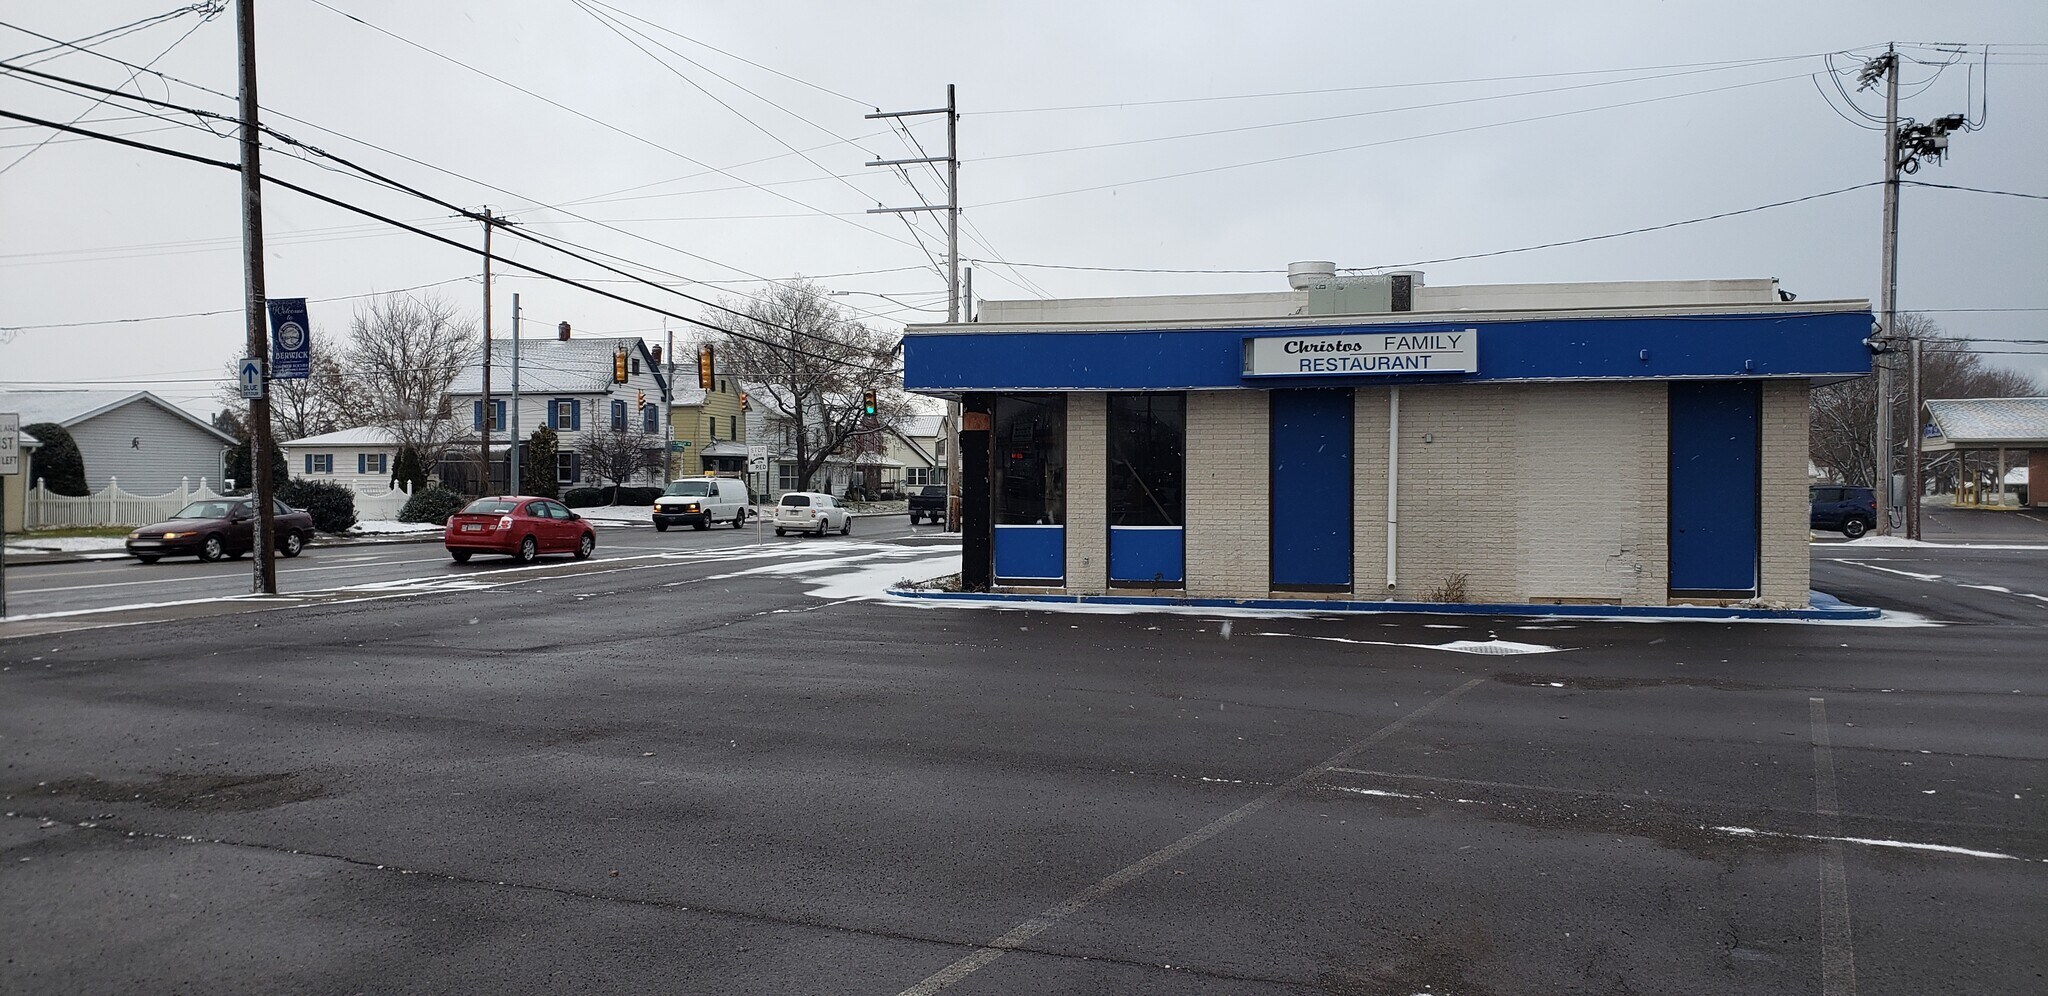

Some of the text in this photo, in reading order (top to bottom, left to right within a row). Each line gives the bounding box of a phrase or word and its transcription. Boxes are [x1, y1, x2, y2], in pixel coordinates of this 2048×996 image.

[272, 305, 303, 315] Welcome
[1284, 335, 1462, 354] Christos FAMILY
[275, 351, 308, 359] BERWICK
[1300, 355, 1432, 371] RESTAURANT
[2, 456, 17, 464] LEFT
